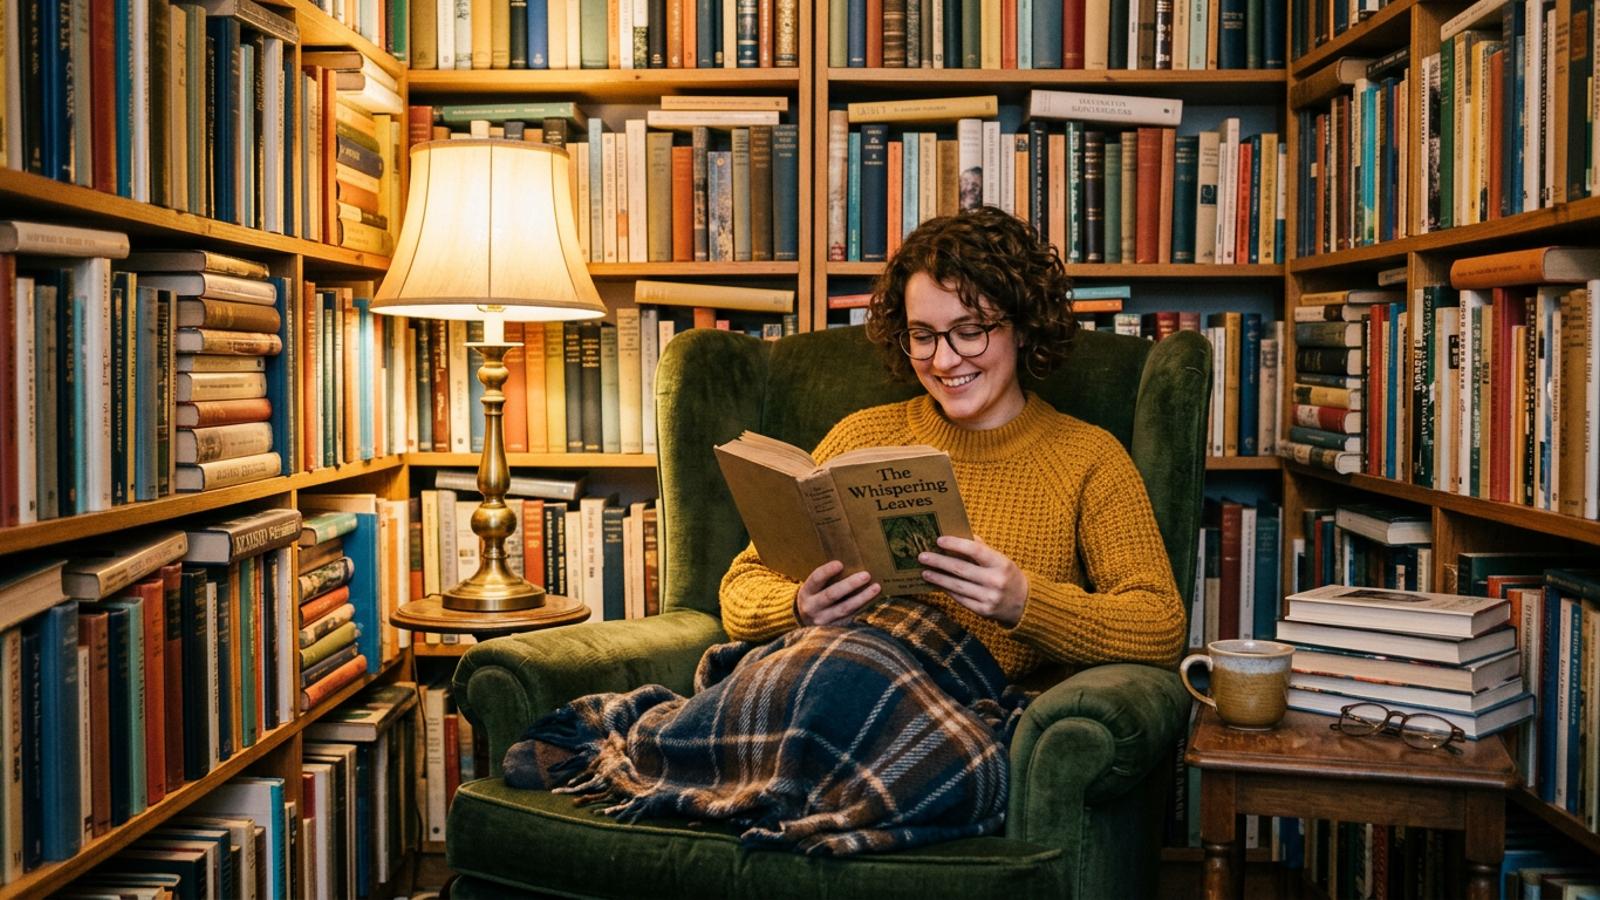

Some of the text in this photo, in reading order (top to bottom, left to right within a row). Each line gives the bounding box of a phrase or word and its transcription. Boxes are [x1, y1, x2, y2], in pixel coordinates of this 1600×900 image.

[876, 467, 911, 481] The
[848, 479, 948, 499] Whispering
[875, 496, 933, 511] Leaves
